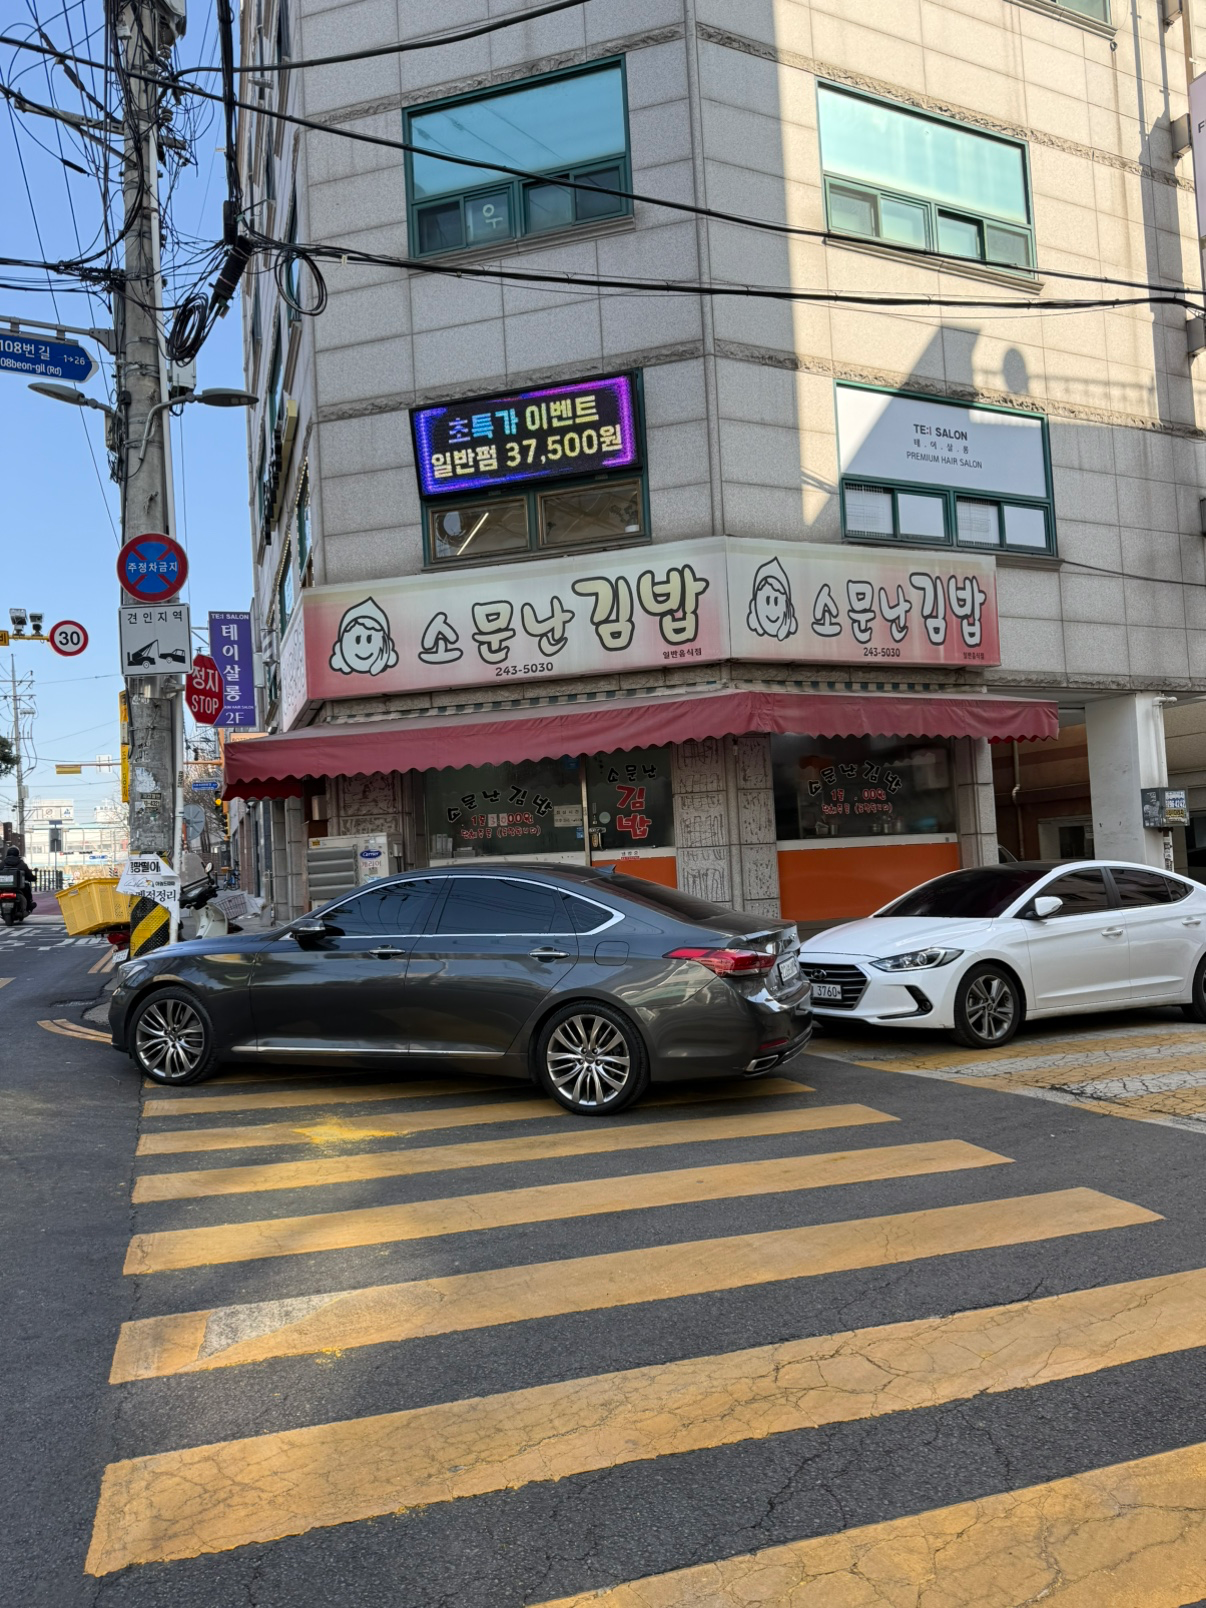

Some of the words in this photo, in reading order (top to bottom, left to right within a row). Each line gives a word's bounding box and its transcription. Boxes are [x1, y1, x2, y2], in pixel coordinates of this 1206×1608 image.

[482, 203, 504, 229] 우
[46, 365, 63, 377] (Rd)
[448, 408, 519, 443] 초특가
[525, 394, 599, 431] 이벤트
[935, 427, 968, 441] SALON
[431, 444, 498, 479] 일반펌
[505, 424, 623, 468] 37,500원
[906, 450, 940, 464] PREMIUM
[941, 455, 959, 466] HAIR
[959, 458, 983, 469] SALON
[127, 561, 178, 573] 주정차금지
[127, 610, 183, 624] 견인지역
[58, 631, 81, 646] 30
[662, 647, 702, 660] 일반음식점
[863, 647, 901, 658] 243-5030
[495, 662, 554, 677] 243-5030
[192, 666, 219, 693] 정지
[191, 694, 219, 715] STOP
[225, 711, 245, 723] 2F
[607, 764, 658, 783] 소문난
[816, 985, 838, 998] 3760
